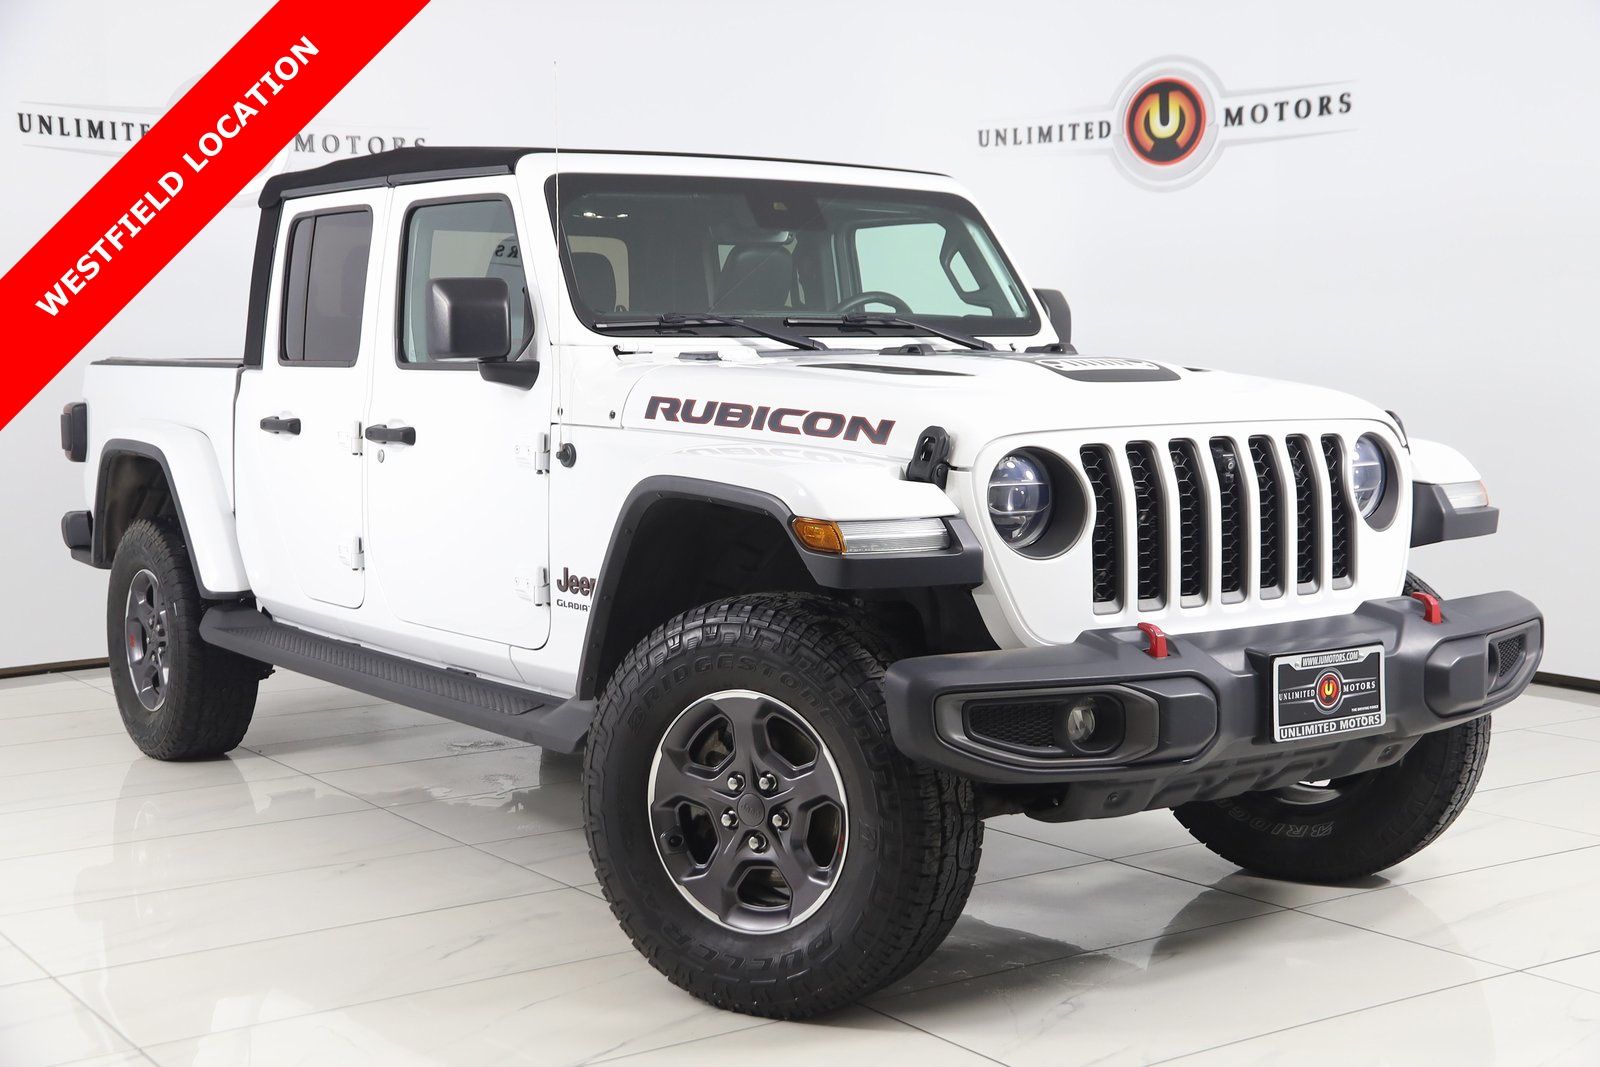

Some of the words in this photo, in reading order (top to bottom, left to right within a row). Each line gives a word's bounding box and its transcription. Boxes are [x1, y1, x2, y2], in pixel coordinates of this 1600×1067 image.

[977, 119, 1112, 148] UNLIMITED
[1223, 92, 1353, 128] MOTORS
[644, 395, 896, 446] RUBICON
[556, 598, 591, 613] GLADIA
[1278, 688, 1316, 701] UNLIMITED
[1343, 680, 1376, 693] MOTORS
[1280, 721, 1337, 739] UNLIMITED
[1340, 714, 1381, 731] MOTORS
